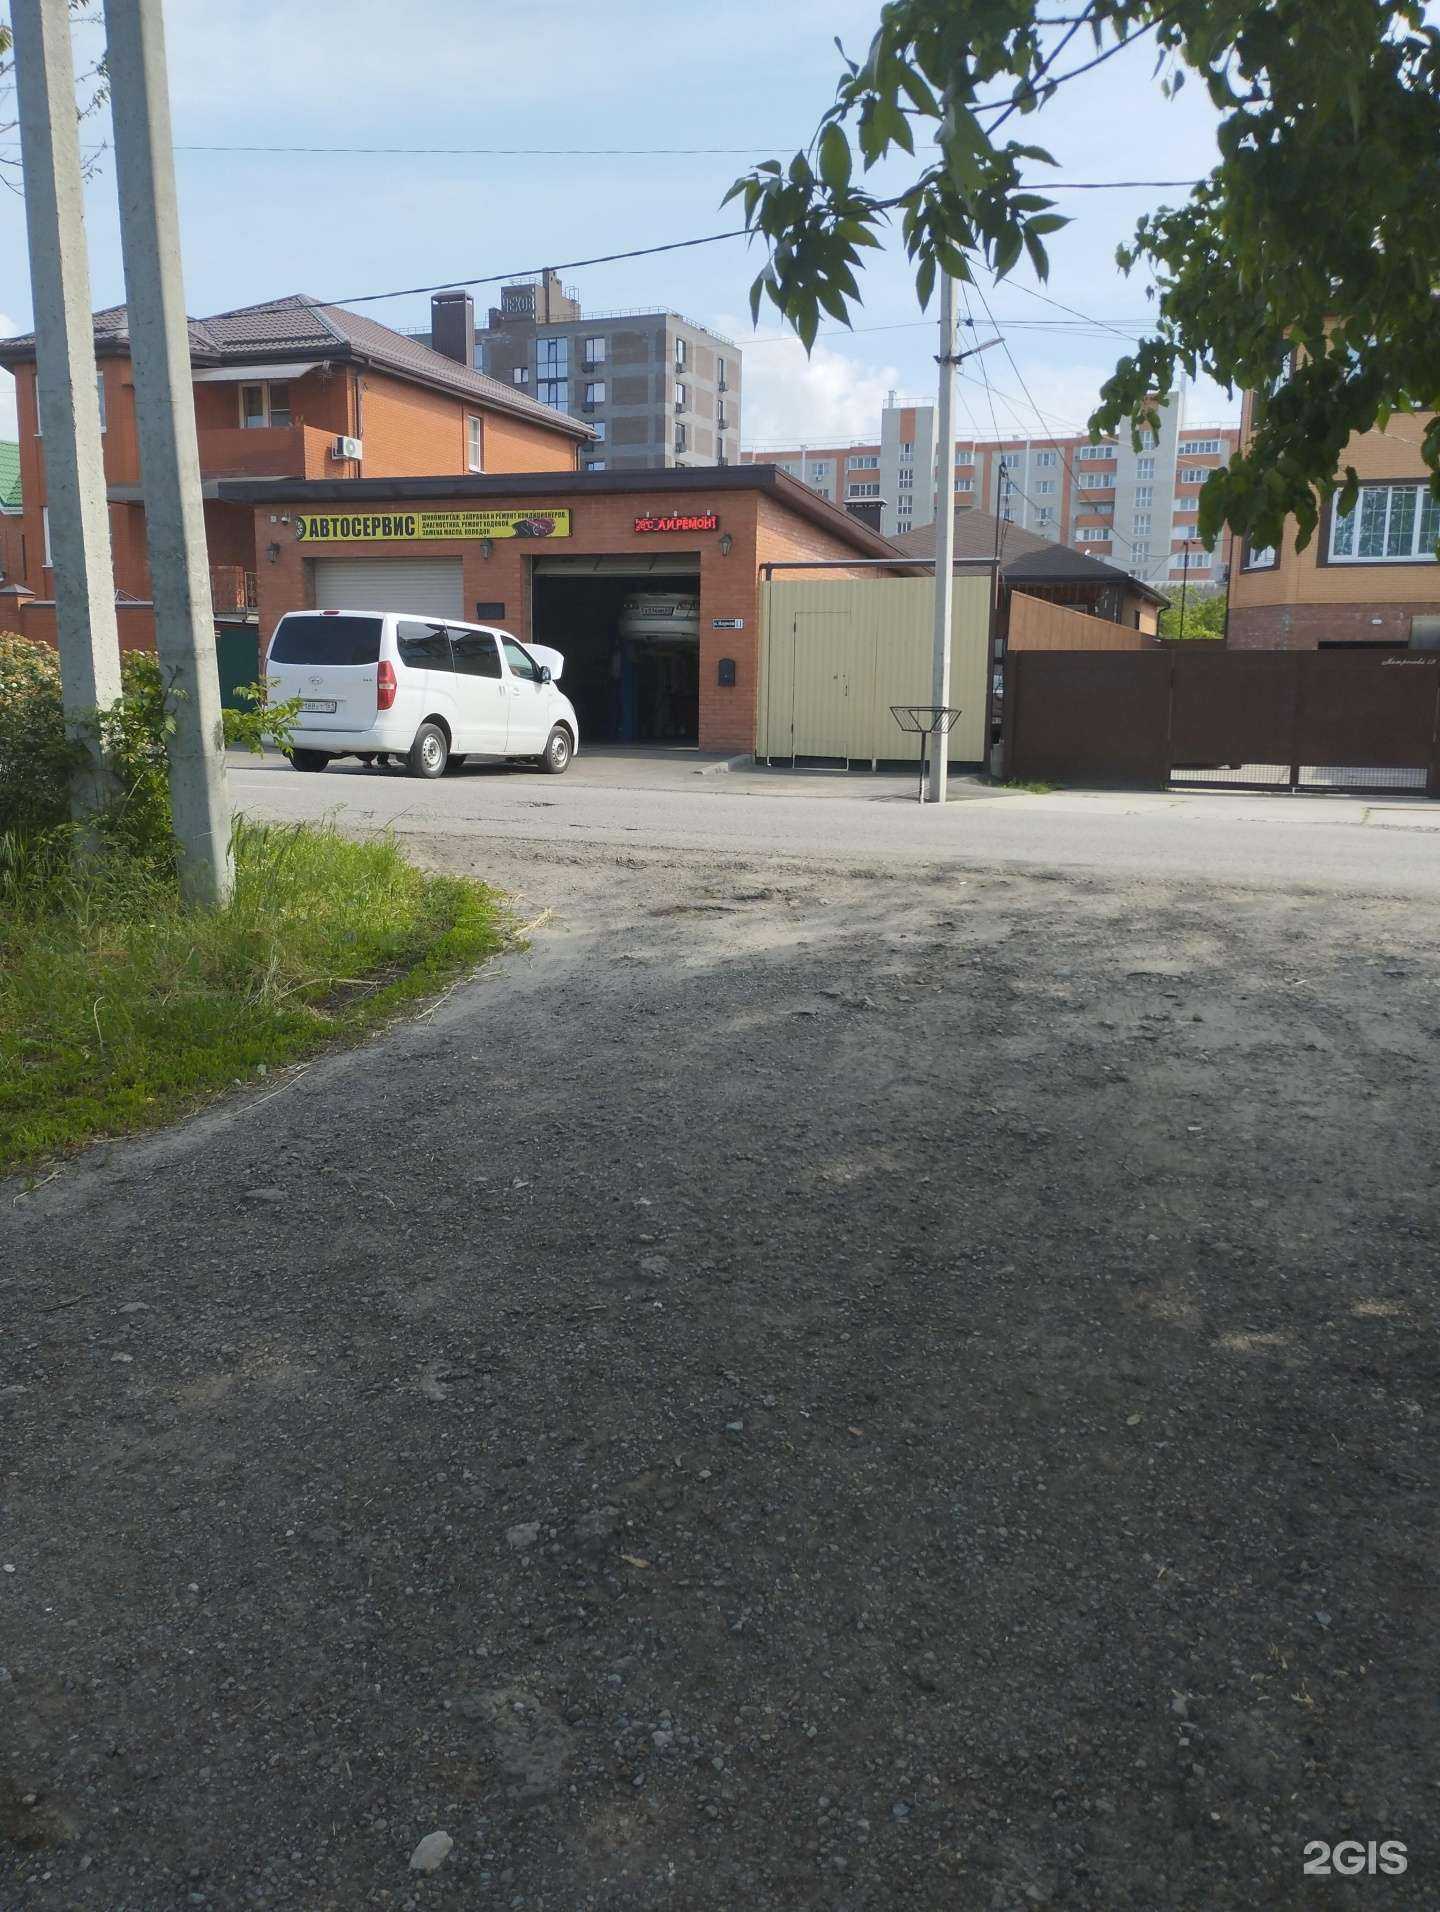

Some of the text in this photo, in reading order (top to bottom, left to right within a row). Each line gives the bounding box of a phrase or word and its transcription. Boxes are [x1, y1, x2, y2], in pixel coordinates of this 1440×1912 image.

[495, 512, 517, 520] РЕМОНТ
[676, 516, 717, 529] РЕМОНТ
[309, 515, 416, 538] АВТОСЕРВИС
